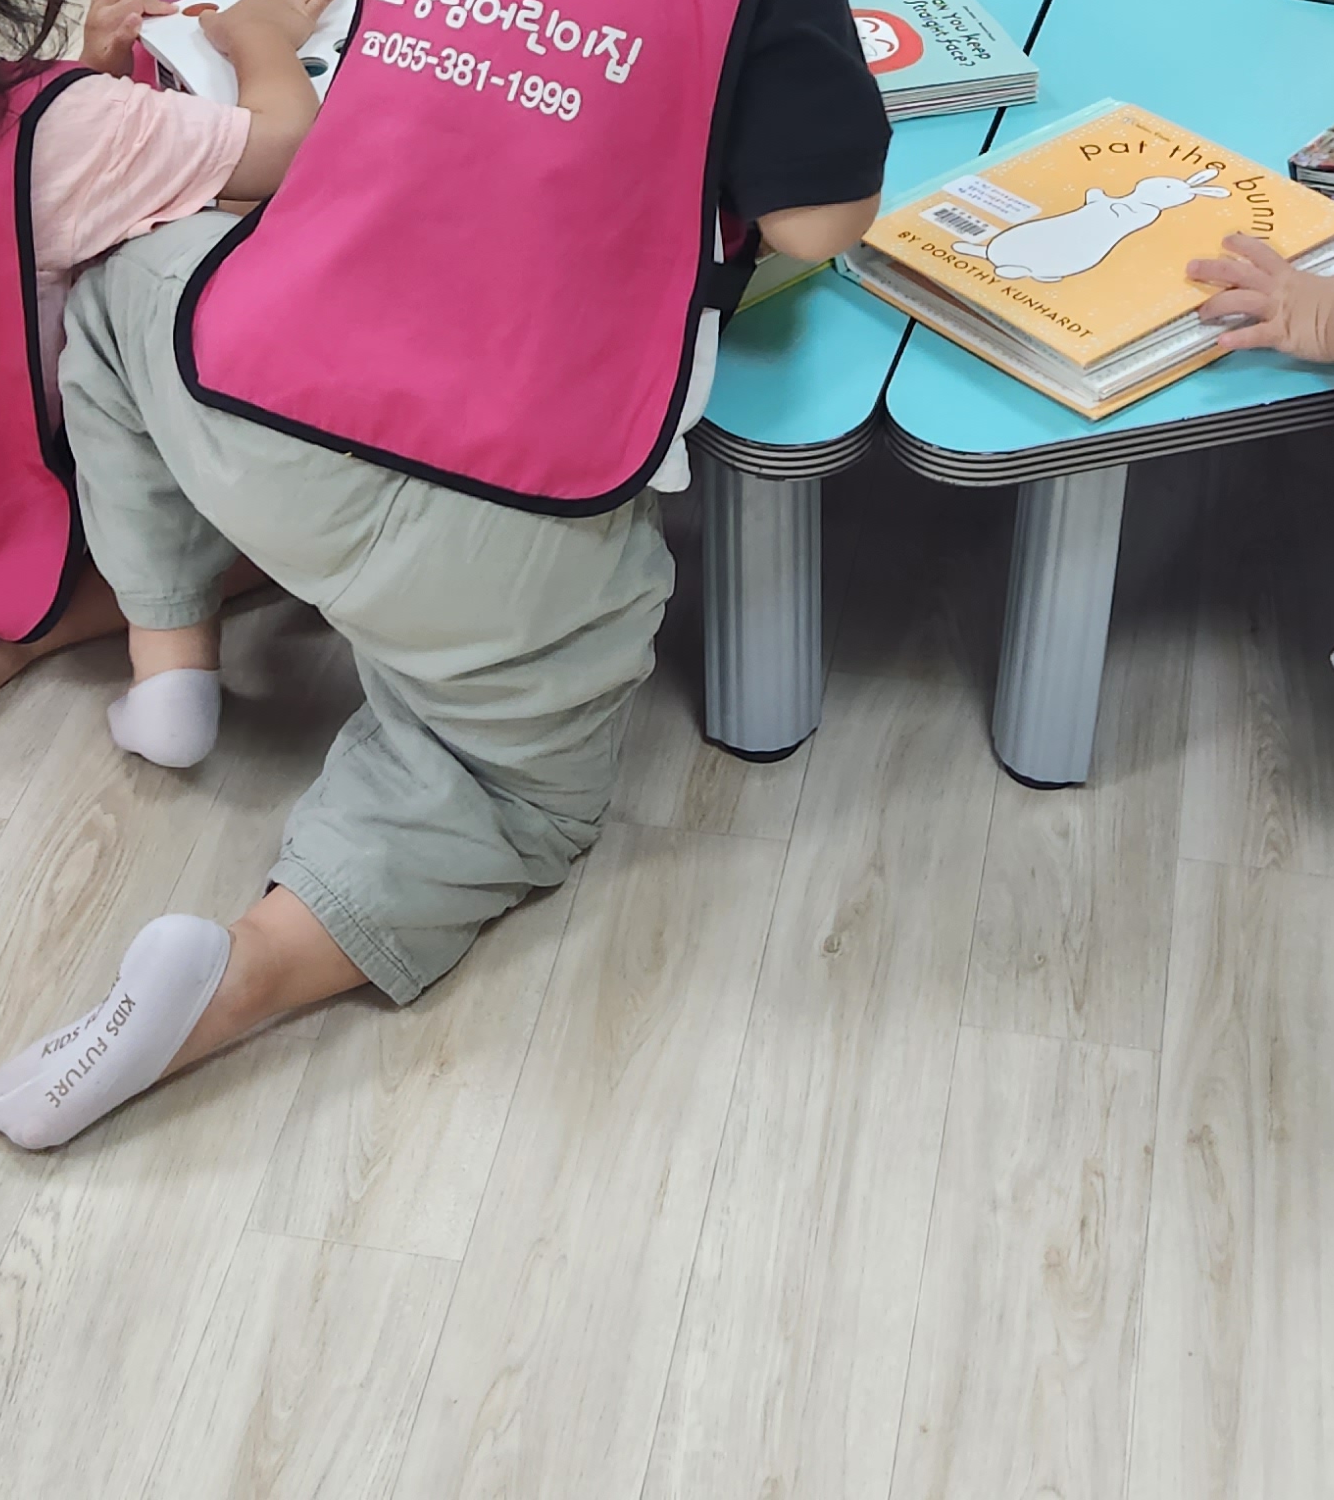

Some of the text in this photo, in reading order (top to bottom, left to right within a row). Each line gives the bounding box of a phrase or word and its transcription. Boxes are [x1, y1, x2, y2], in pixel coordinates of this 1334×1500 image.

[381, 31, 583, 122] 055-381-1999
[1078, 139, 1275, 240] pat the bunn
[896, 230, 1095, 341] BY DOROTHY KUNHARDT
[40, 1026, 81, 1059] KIDS
[105, 993, 137, 1037] KIDS
[44, 1036, 109, 1109] FUTURE
